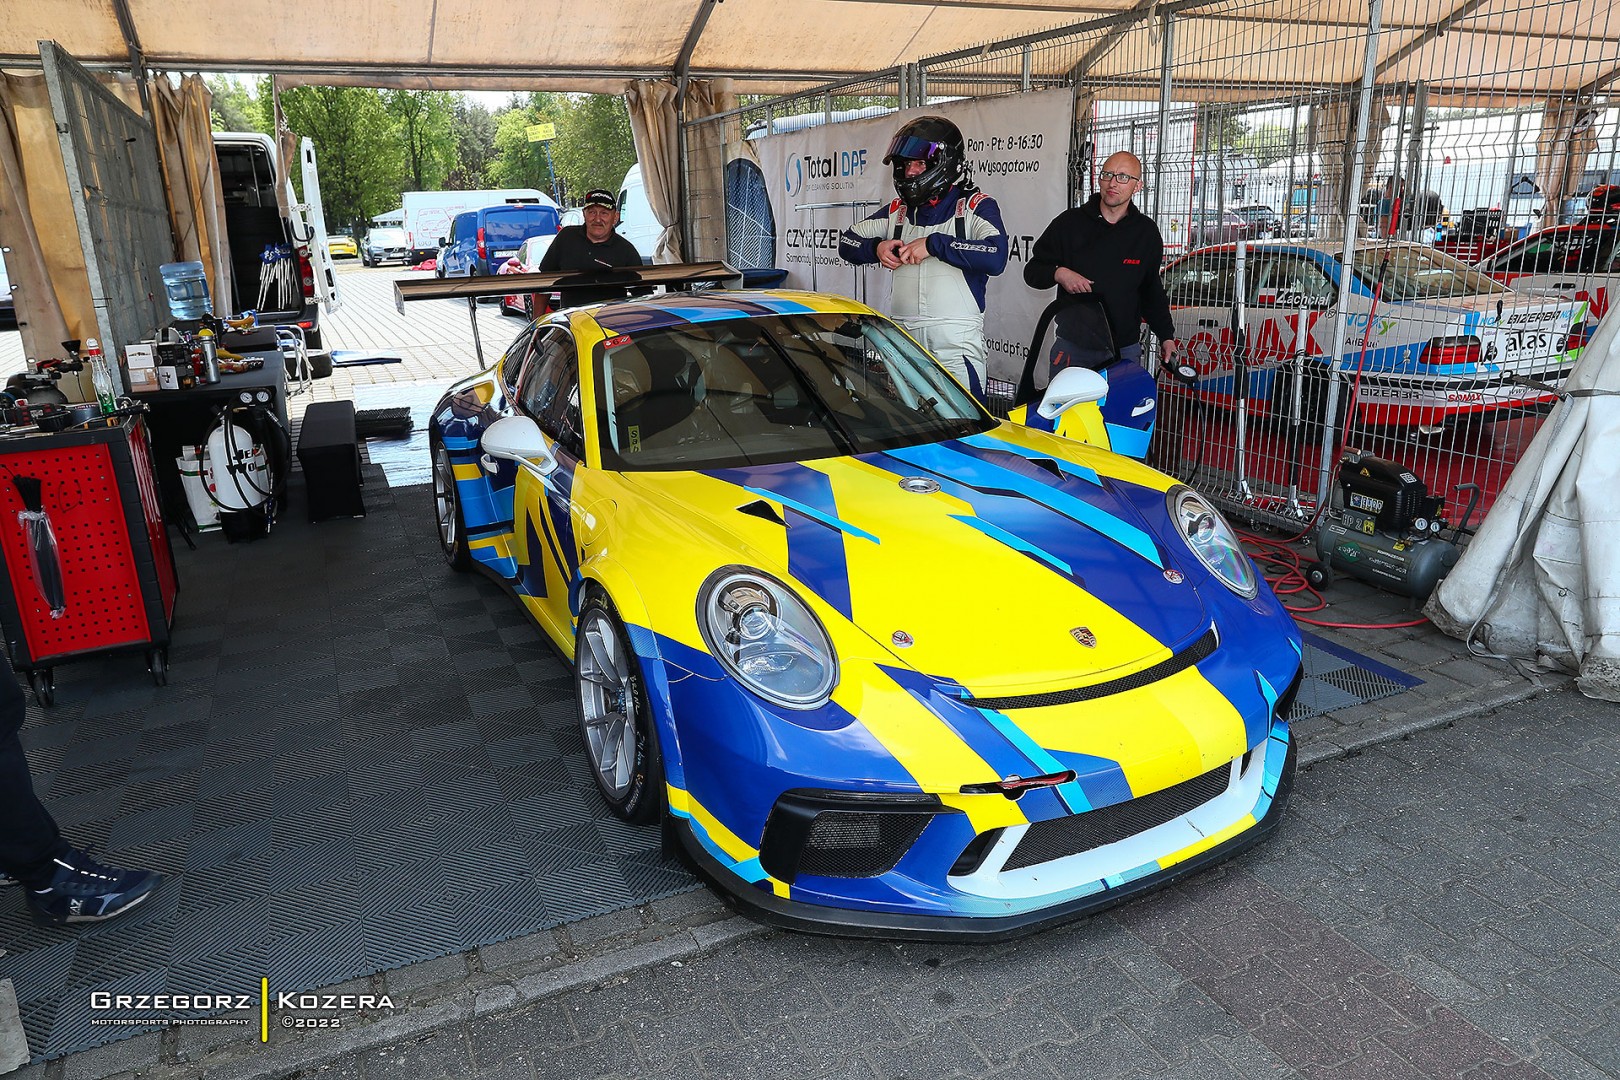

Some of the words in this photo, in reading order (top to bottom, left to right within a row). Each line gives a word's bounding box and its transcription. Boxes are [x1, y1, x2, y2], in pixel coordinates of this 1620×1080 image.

[967, 138, 984, 152] Pon
[991, 137, 1005, 151] Pt:
[1007, 134, 1043, 150] 8-16:30
[804, 151, 837, 179] Total
[841, 149, 867, 177] DPF
[979, 159, 1040, 176] Wysogotowo
[1507, 311, 1561, 324] BIZERBA
[985, 338, 1030, 360] otaldpf.p
[1345, 338, 1378, 348] AdBue
[1360, 387, 1420, 400] BIZERBA
[1448, 393, 1481, 403] SONAX
